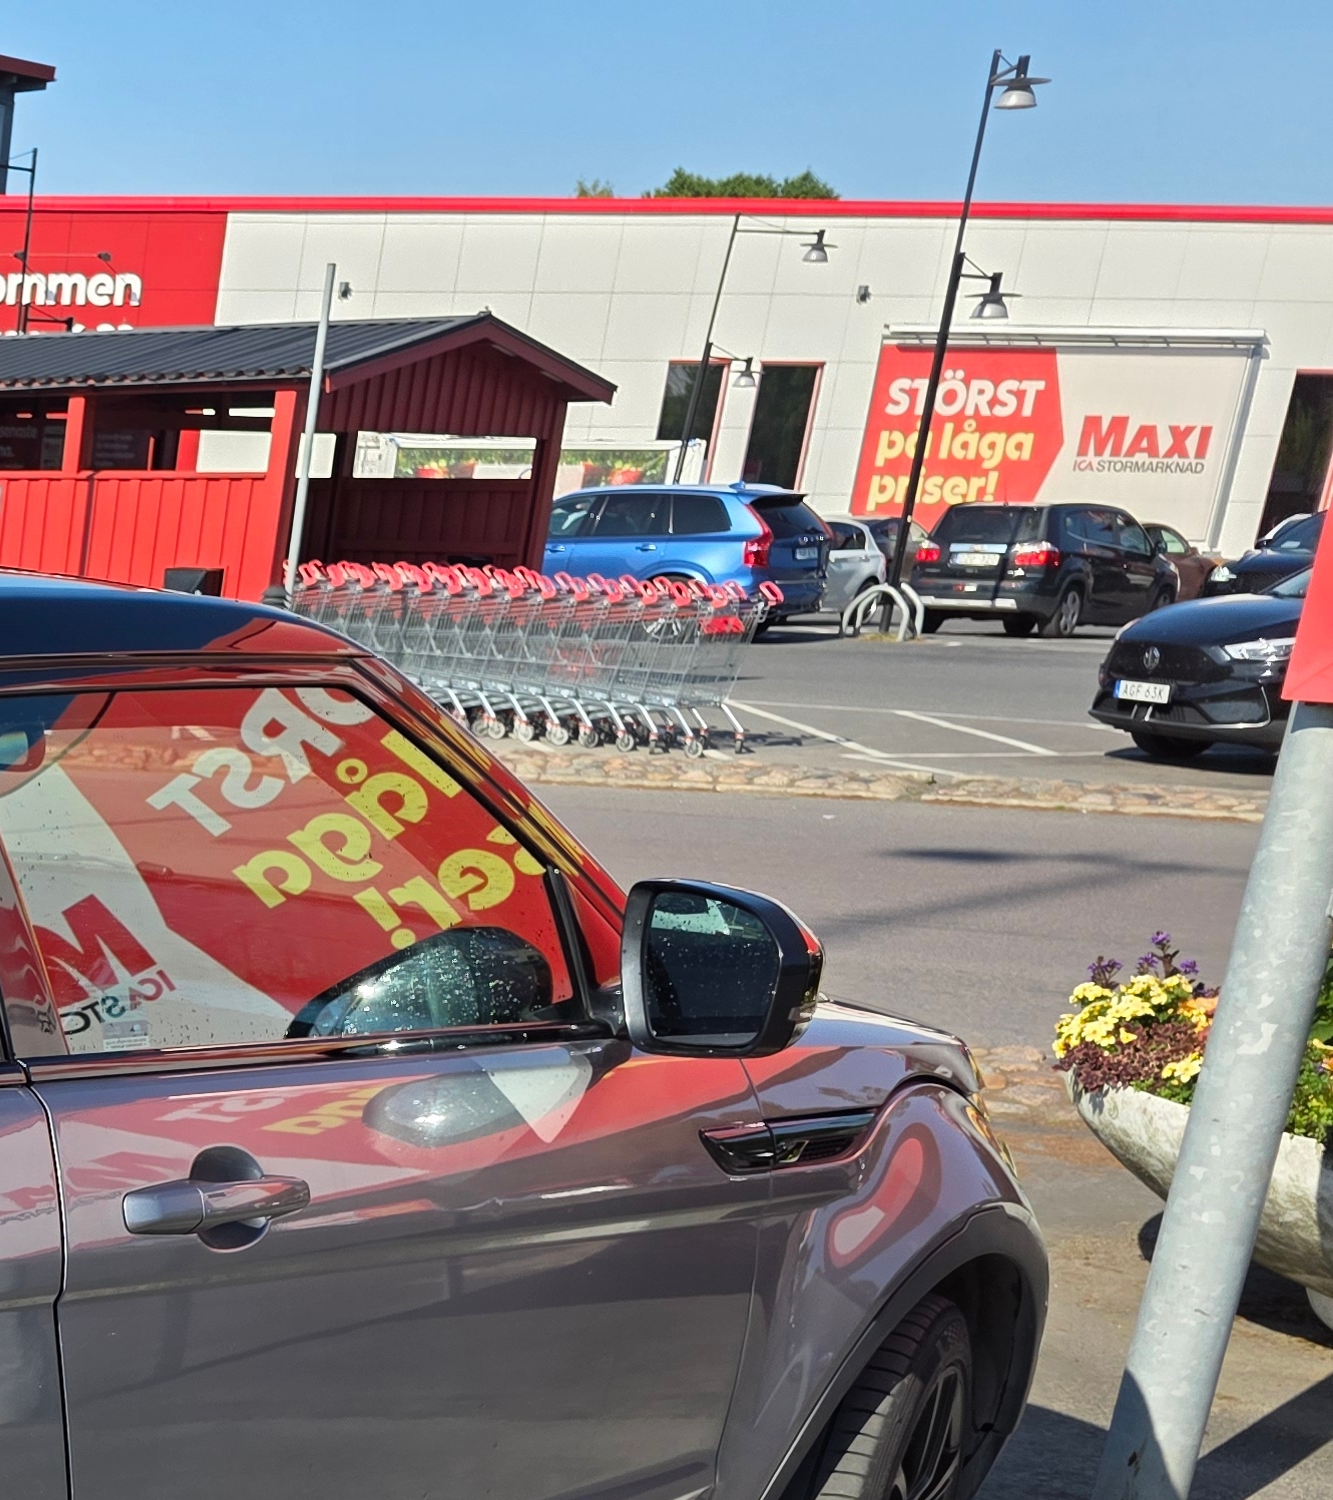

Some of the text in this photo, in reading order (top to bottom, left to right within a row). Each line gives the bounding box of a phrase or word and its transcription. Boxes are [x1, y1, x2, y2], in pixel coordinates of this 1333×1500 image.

[885, 369, 1046, 417] STÖRST
[875, 419, 1035, 469] på låga
[1076, 415, 1213, 459] MAXI
[866, 466, 999, 511] priser!
[1073, 460, 1205, 474] ICA STORMARKNAD
